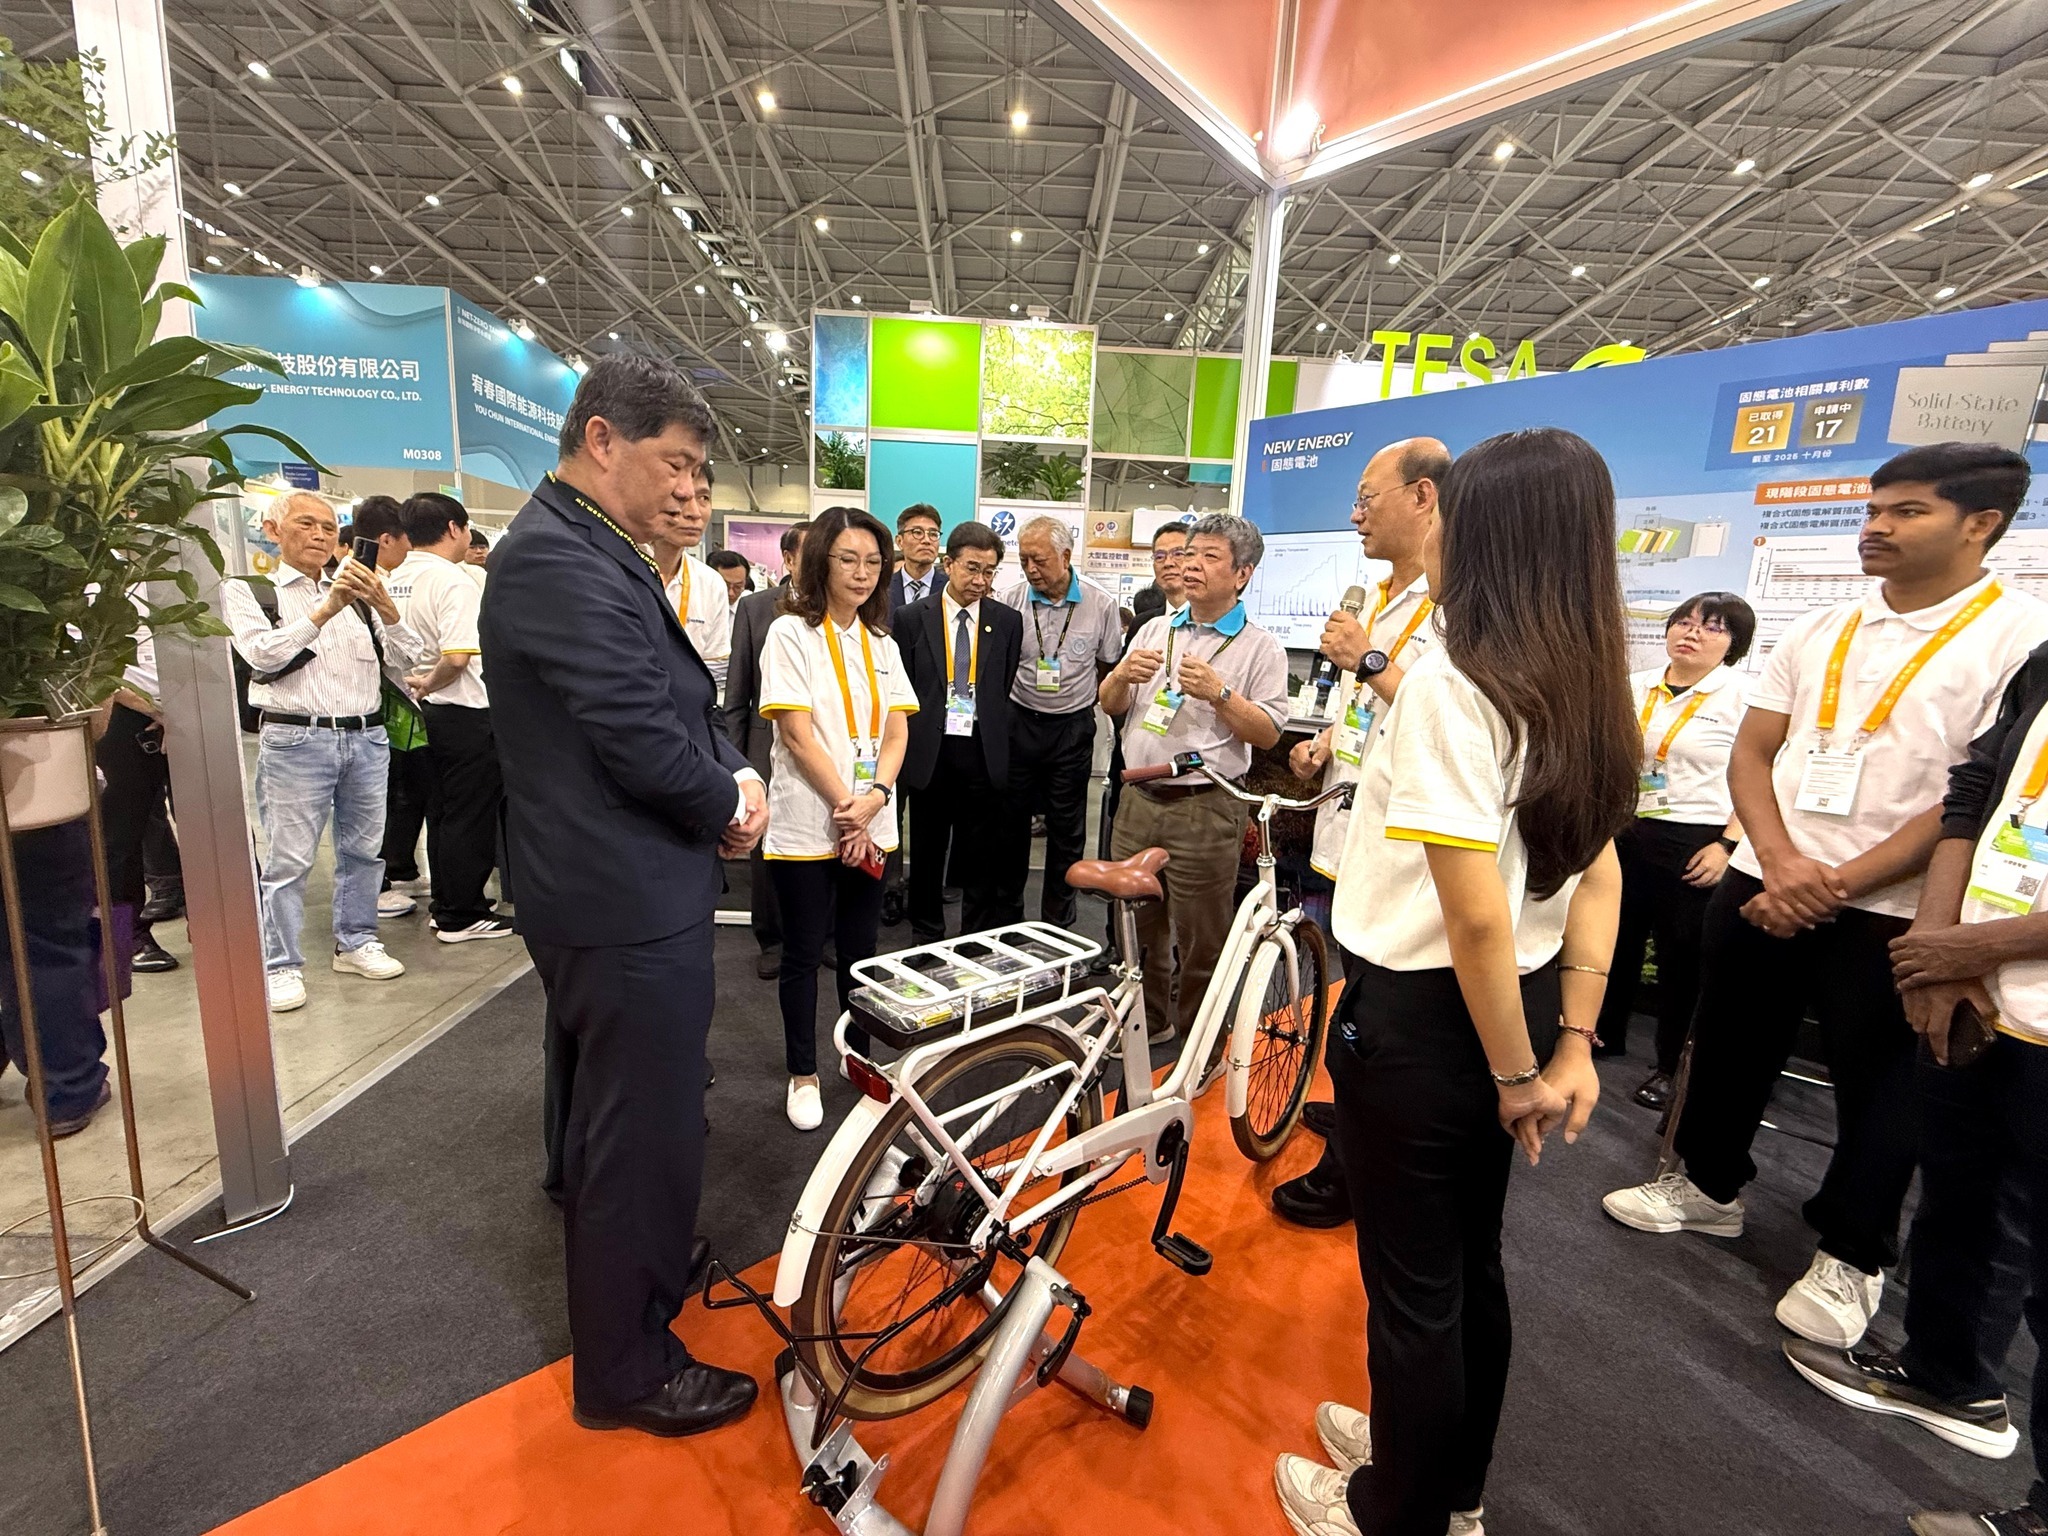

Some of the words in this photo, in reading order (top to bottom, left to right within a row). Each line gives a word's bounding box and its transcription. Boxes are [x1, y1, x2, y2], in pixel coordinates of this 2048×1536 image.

[230, 352, 420, 382] 技股份有限公司
[271, 384, 310, 396] ENERGY
[311, 386, 379, 400] TECHNOLOGY
[380, 390, 400, 401] CO.,
[401, 391, 422, 401] LTD.
[1738, 377, 1871, 404] 固態電池相關專利數
[1813, 402, 1852, 415] 申請中
[1907, 392, 2019, 413] Solid-State
[475, 403, 487, 416] YOU
[487, 408, 504, 423] CHUN
[505, 416, 544, 440] INTERNATIONAL
[544, 432, 561, 446] ENERG
[1748, 410, 1784, 422] 已取得
[1918, 413, 1994, 437] Battery
[1748, 425, 1776, 445] 21
[1815, 419, 1843, 439] 17
[1263, 439, 1296, 456] NEW
[1297, 431, 1354, 452] ENERGY
[403, 448, 442, 461] M0308
[1270, 454, 1319, 472] 固態電池
